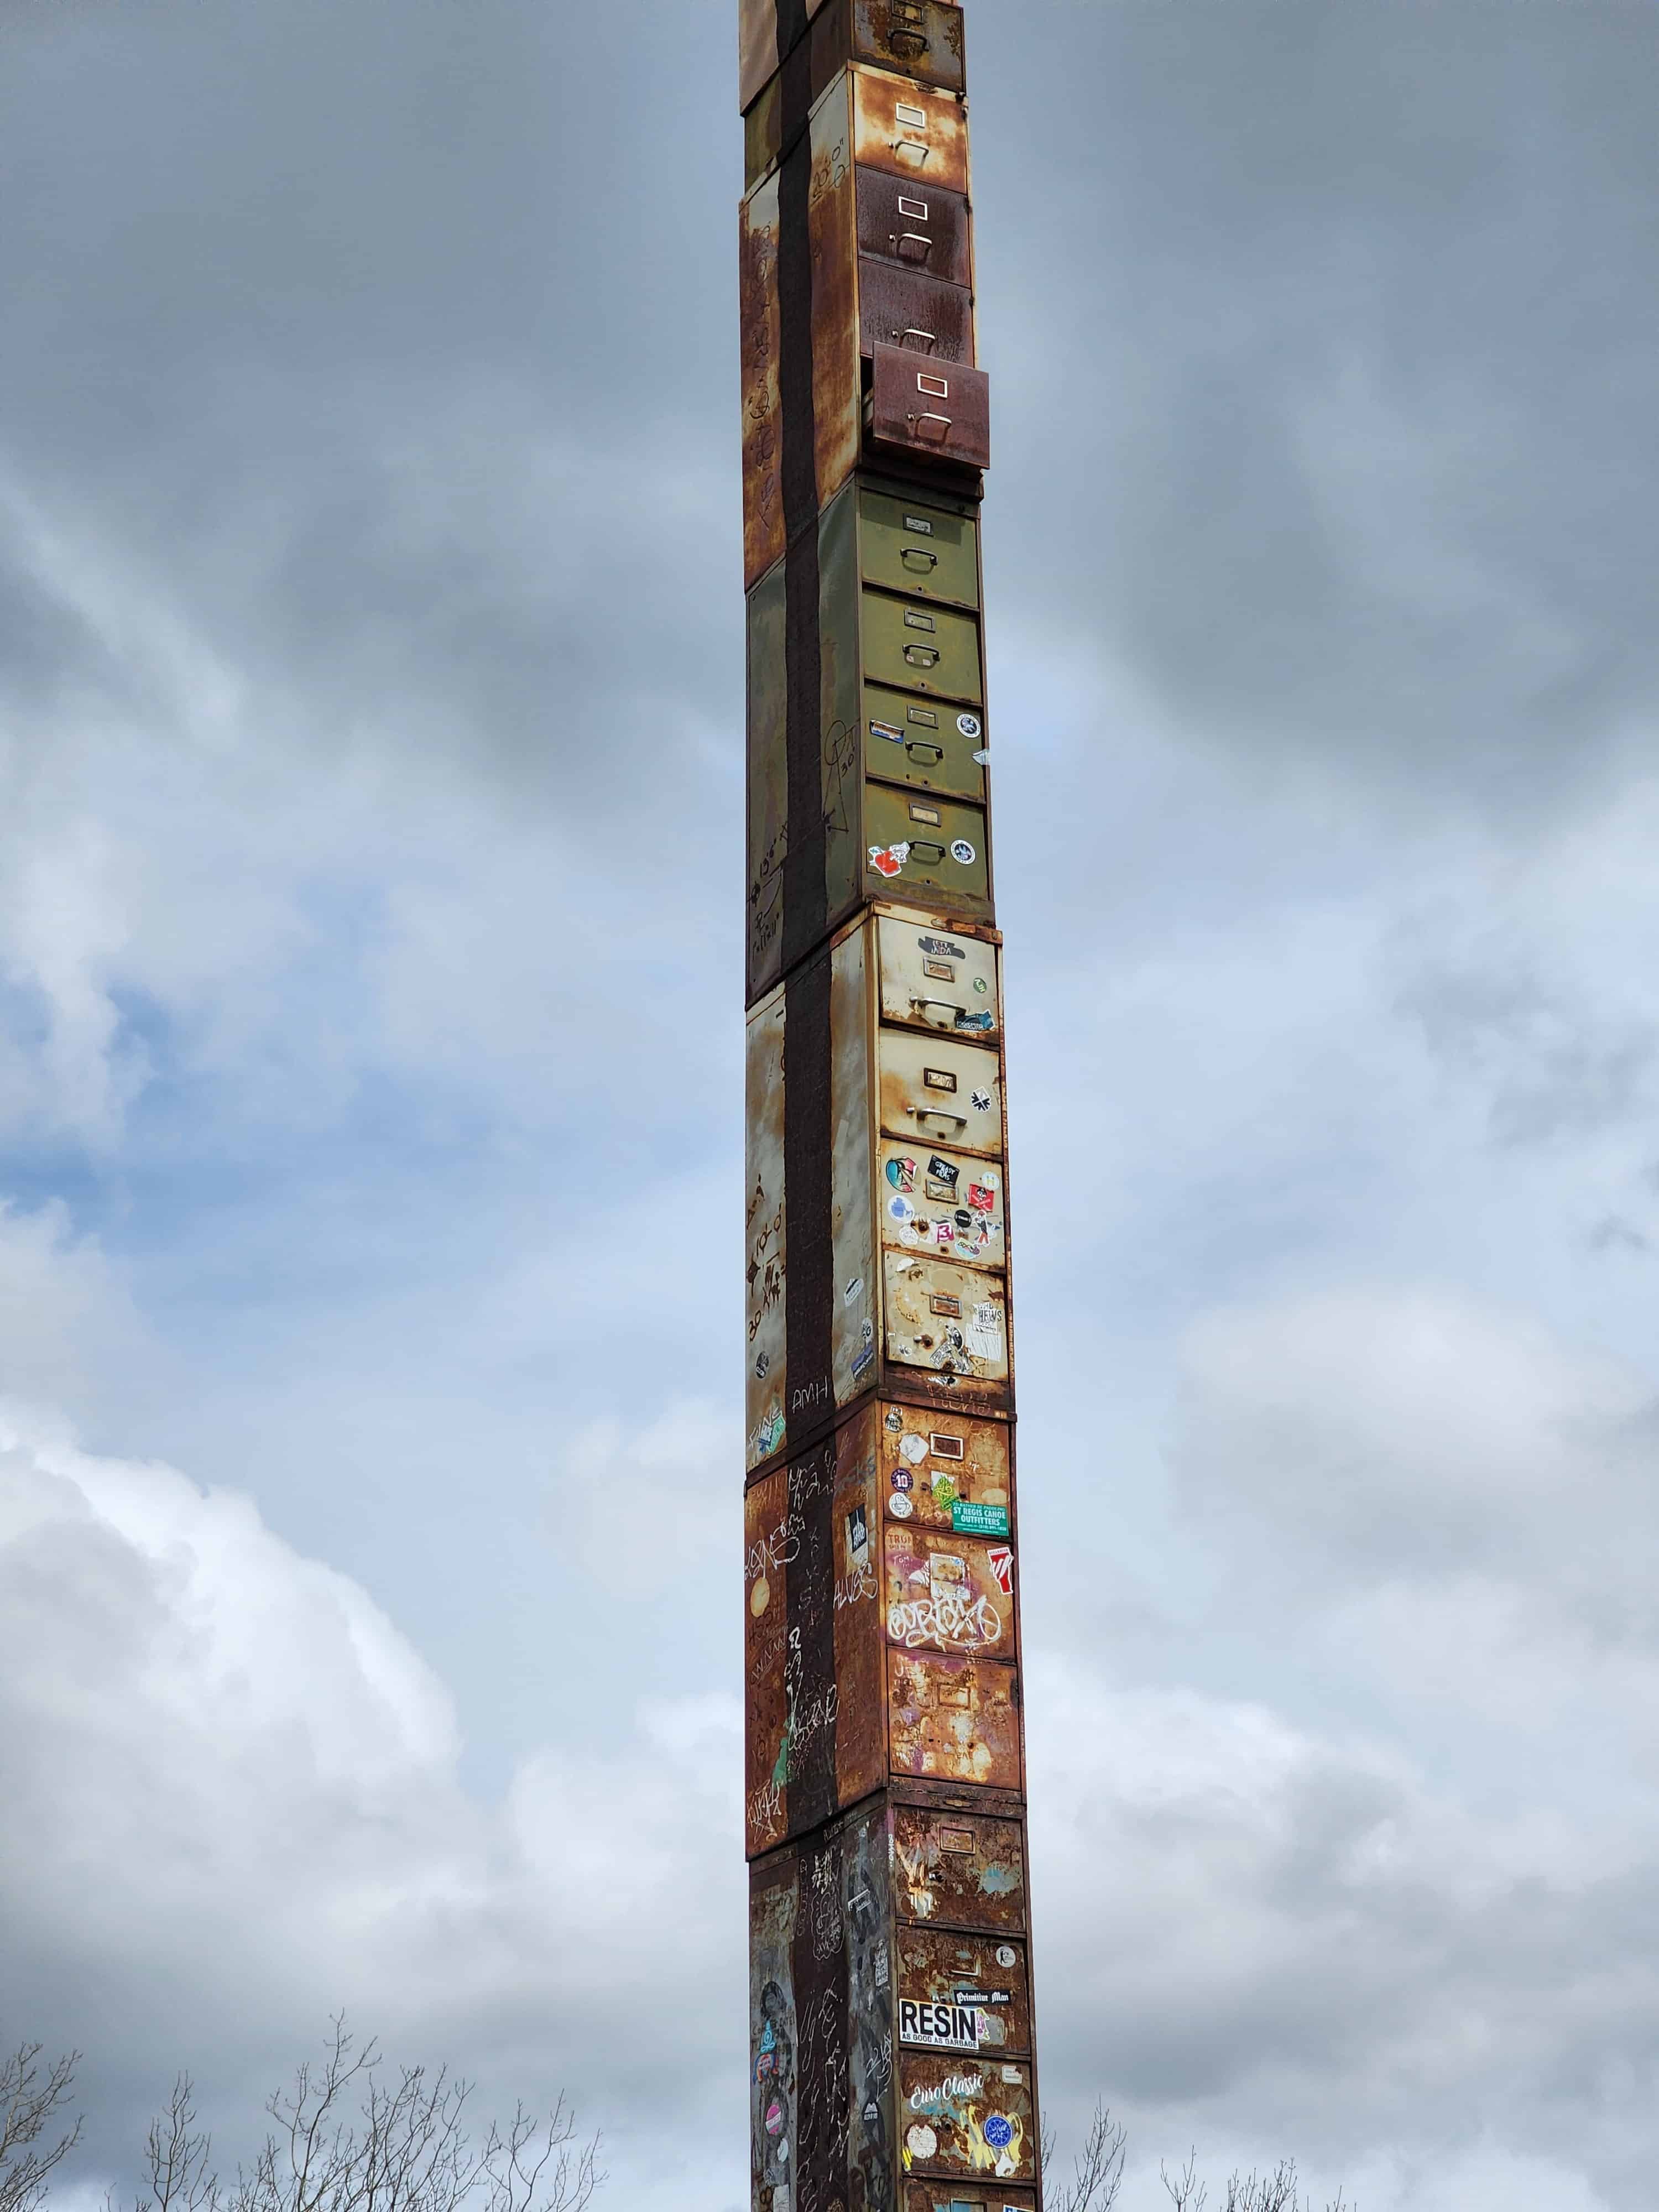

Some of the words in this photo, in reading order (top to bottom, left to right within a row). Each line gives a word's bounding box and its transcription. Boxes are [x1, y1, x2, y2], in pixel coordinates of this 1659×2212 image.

[896, 1474, 908, 1488] 10
[961, 1515, 1000, 1526] OUTFITTERS
[963, 1508, 983, 1517] REGIS
[984, 1510, 1006, 1520] CANOE
[956, 1992, 989, 2005] Primitive
[992, 1992, 1009, 2004] Man
[901, 2001, 977, 2041] RESIN
[945, 2038, 978, 2049] GARBAGE
[942, 2073, 985, 2100] Classic
